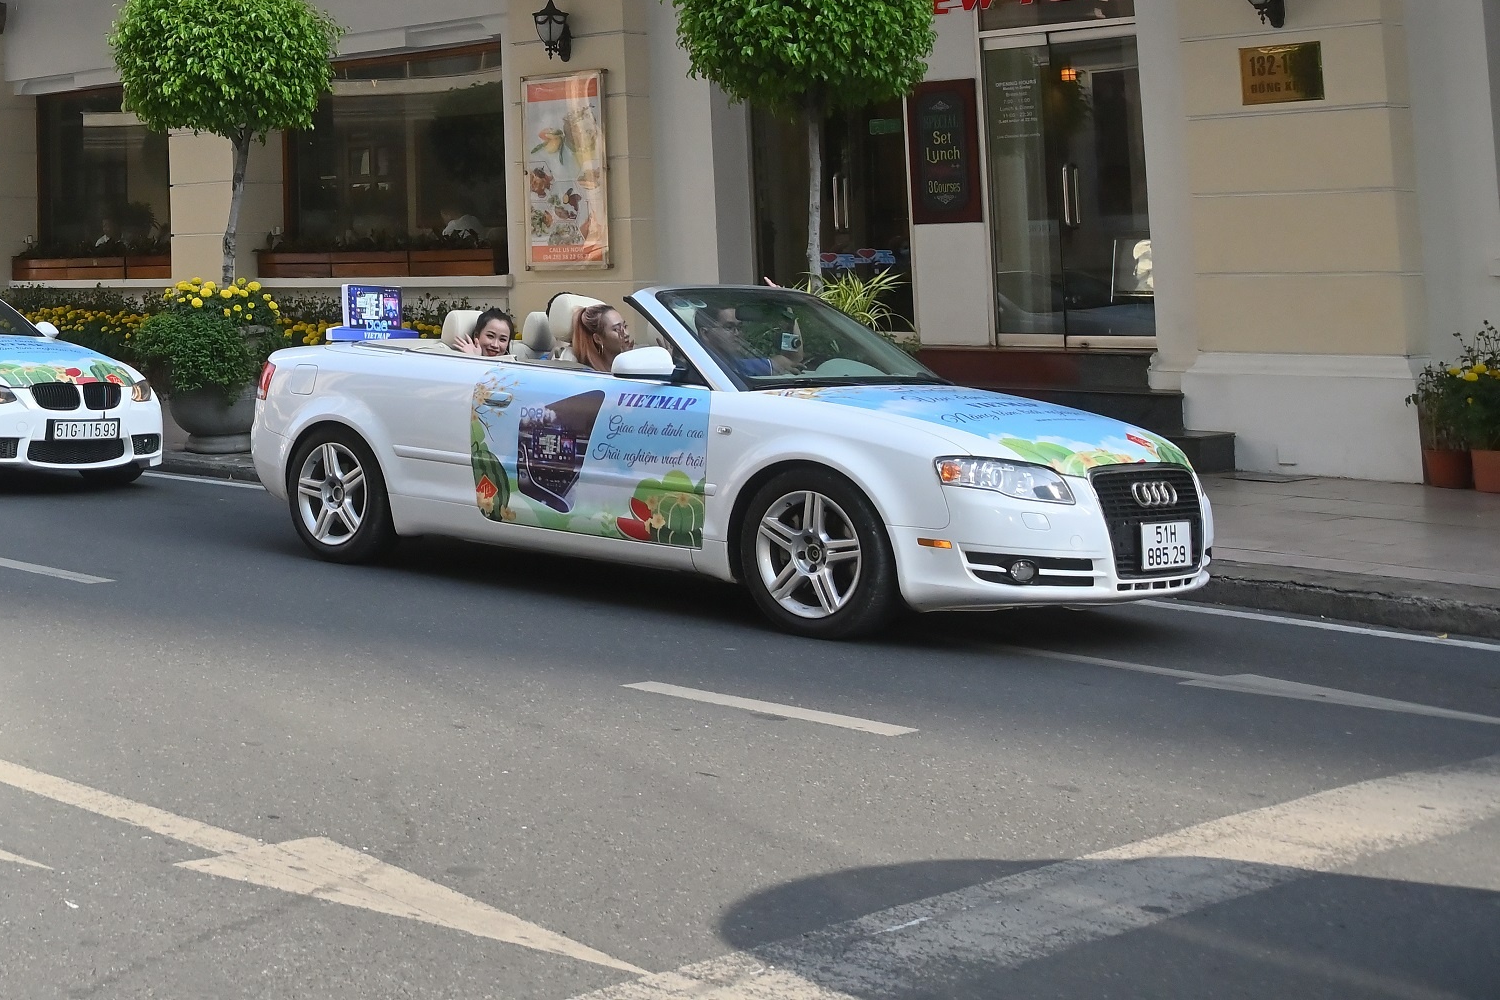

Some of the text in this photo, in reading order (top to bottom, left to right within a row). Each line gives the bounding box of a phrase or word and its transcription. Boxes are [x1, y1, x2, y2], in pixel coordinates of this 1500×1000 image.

[932, 130, 952, 145] Set
[925, 146, 961, 164] Lunch
[366, 320, 388, 331] DQ8
[617, 392, 698, 411] VIETMAP
[520, 407, 543, 419] DQ8
[56, 423, 116, 438] 51G-115.93
[606, 414, 635, 439] Giao
[686, 429, 705, 438] cao
[1155, 524, 1177, 544] 51H
[1147, 545, 1186, 567] 885.29
